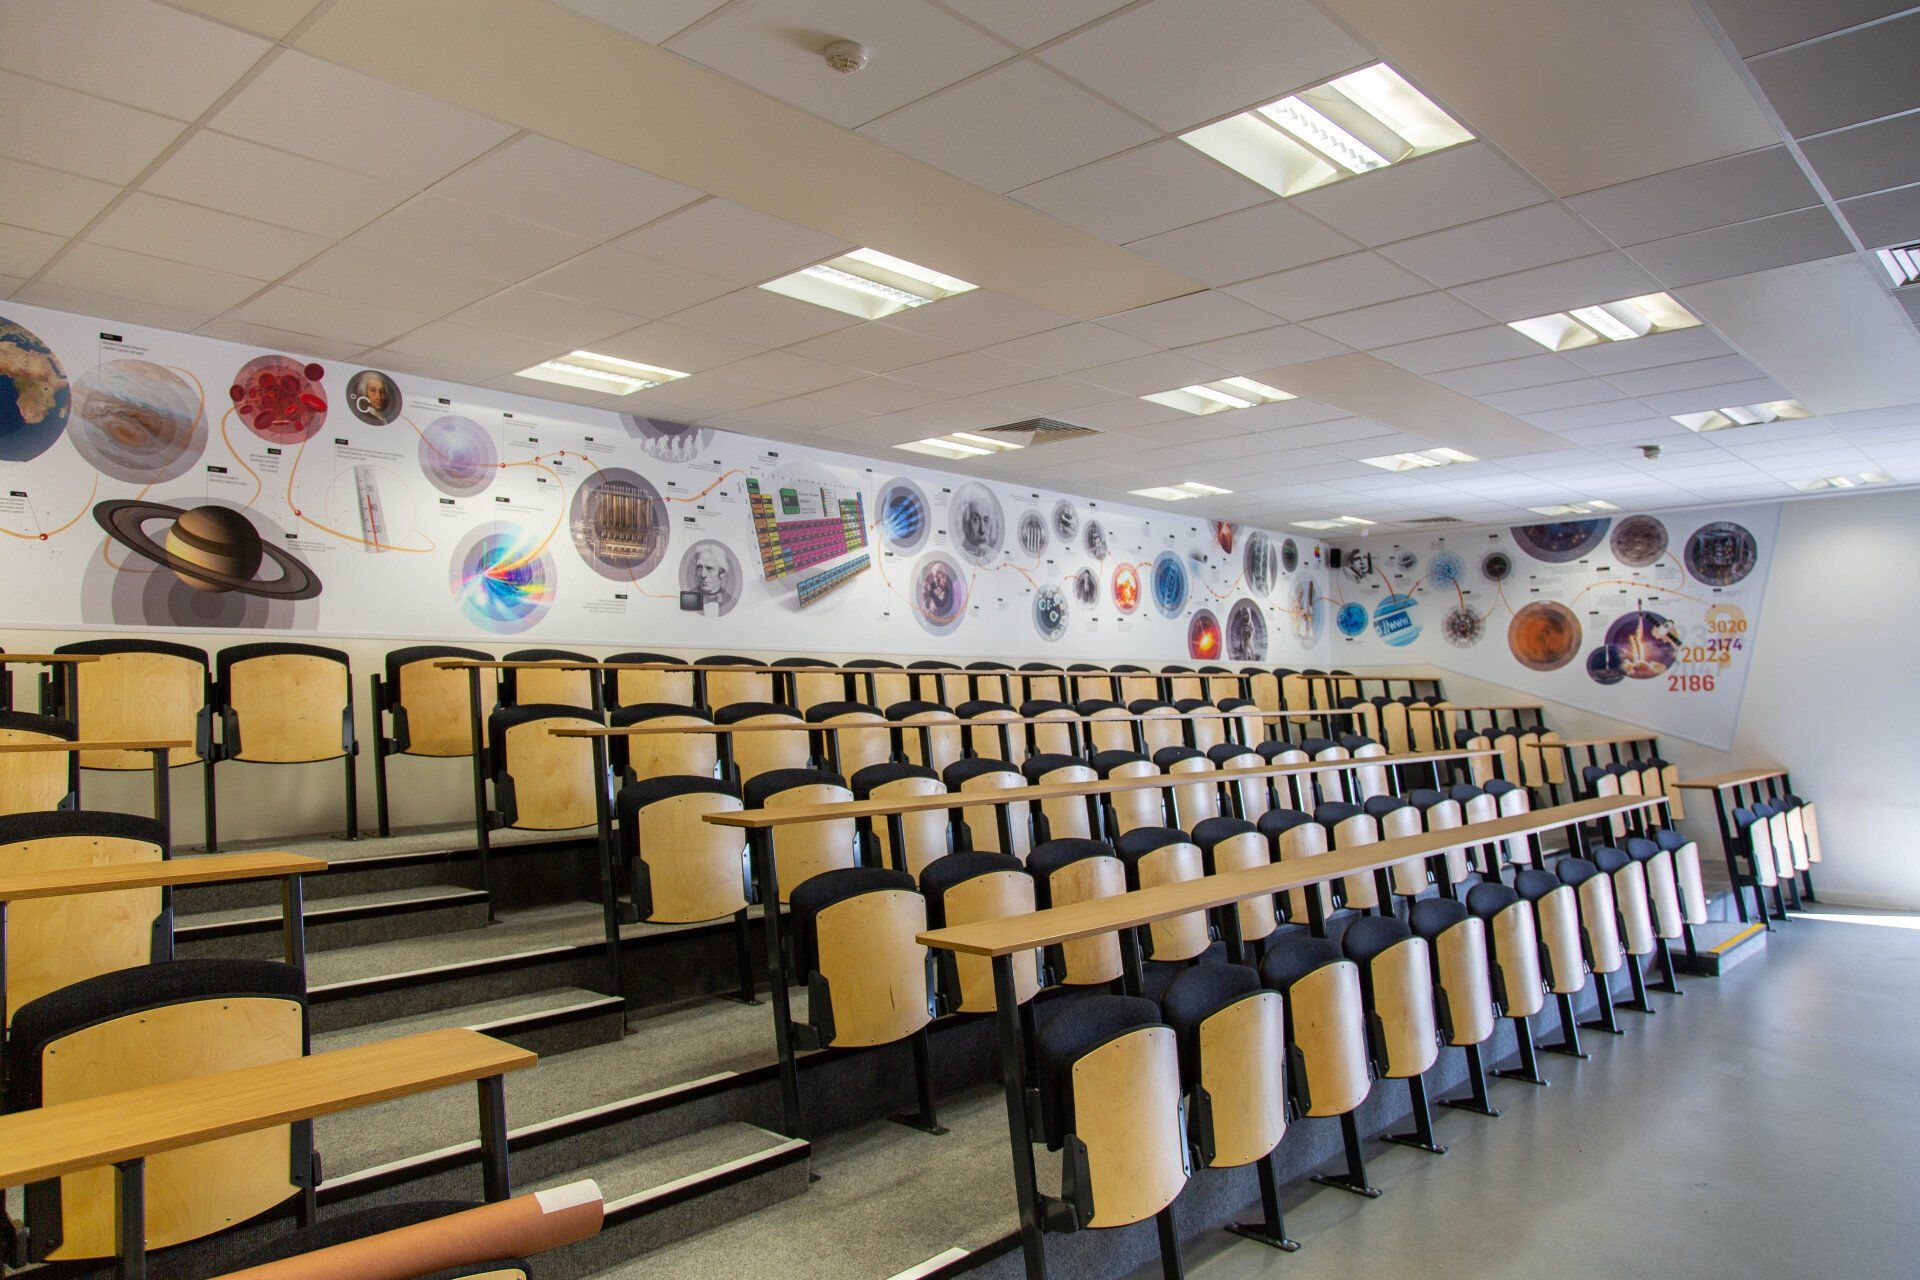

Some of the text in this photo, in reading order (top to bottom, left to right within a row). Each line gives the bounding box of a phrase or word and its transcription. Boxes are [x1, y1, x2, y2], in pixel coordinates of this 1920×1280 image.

[1707, 619, 1748, 634] 3020
[1707, 638, 1743, 652] 2174
[1681, 646, 1731, 663] 2023
[1667, 674, 1714, 692] 2186
